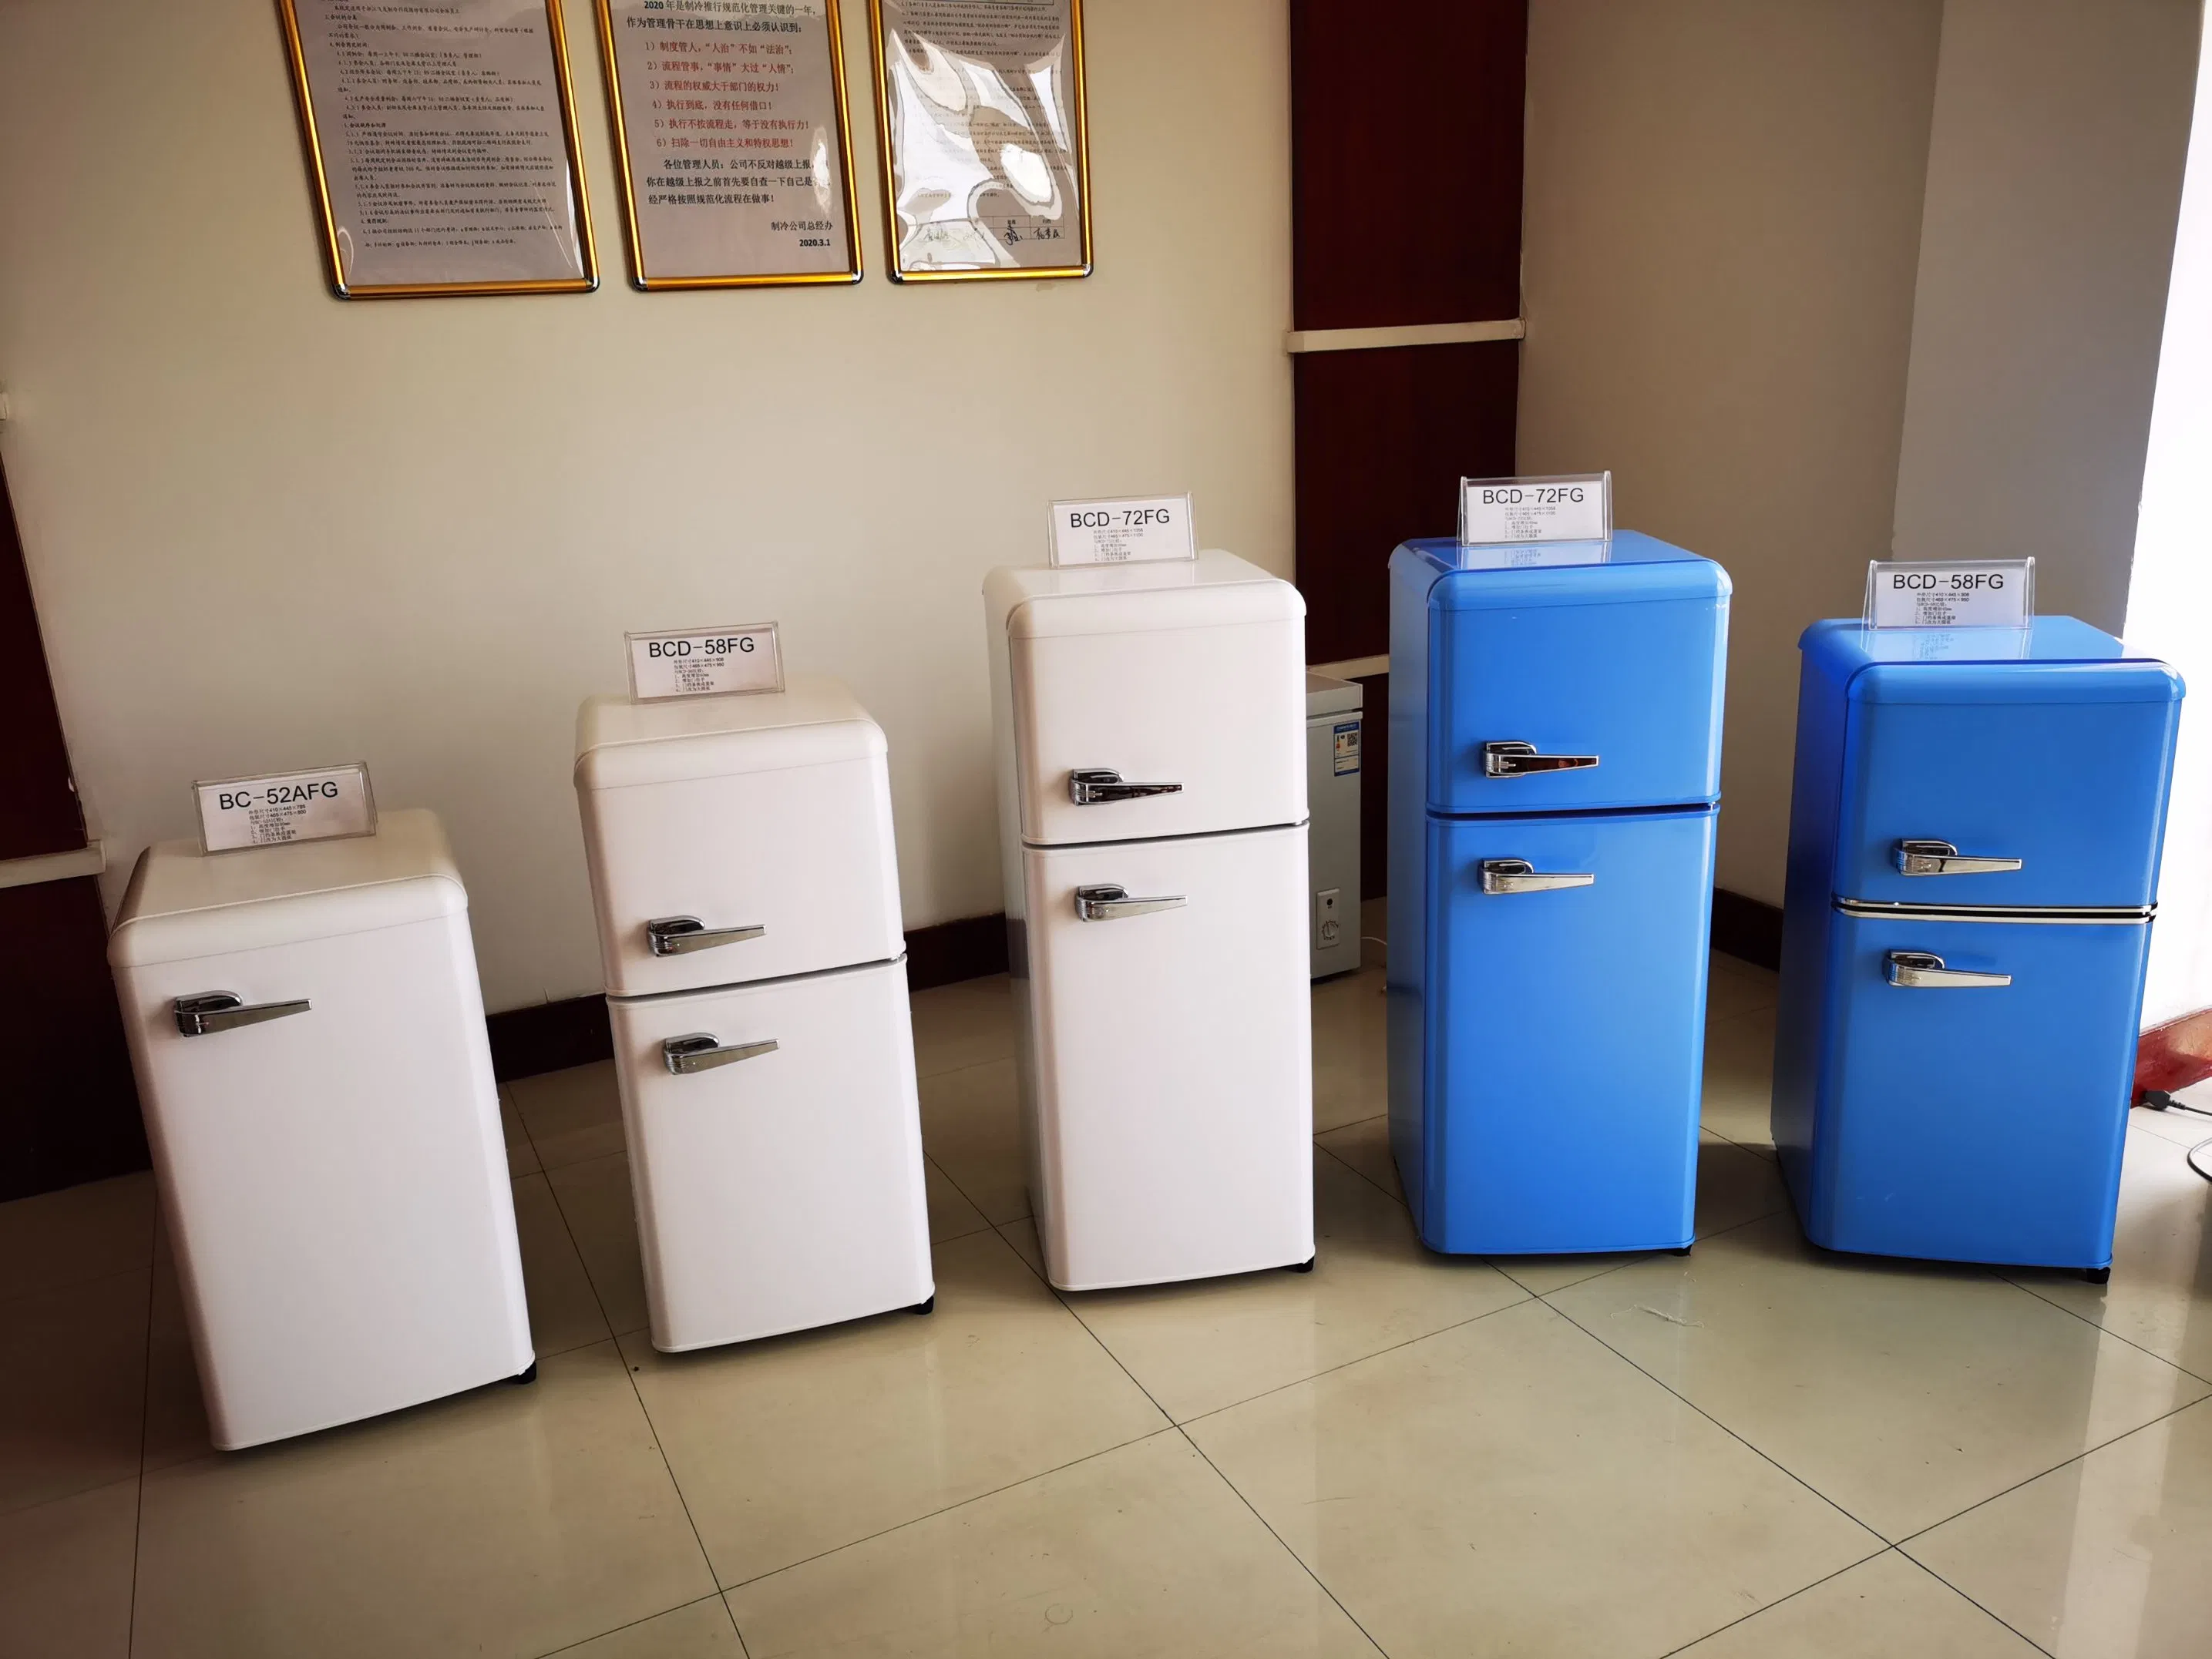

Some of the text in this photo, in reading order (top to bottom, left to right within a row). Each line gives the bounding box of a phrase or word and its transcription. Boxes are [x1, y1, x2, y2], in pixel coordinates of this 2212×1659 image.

[771, 221, 833, 231] 制冷公司总经办
[799, 239, 830, 247] 2020.3.1
[1483, 487, 1584, 505] BCD-72FG
[1070, 509, 1170, 528] BCD-72FG
[1893, 574, 2004, 589] BCD-58FG
[649, 636, 755, 658] BCD-58FG
[219, 781, 338, 810] BC-52AFG
